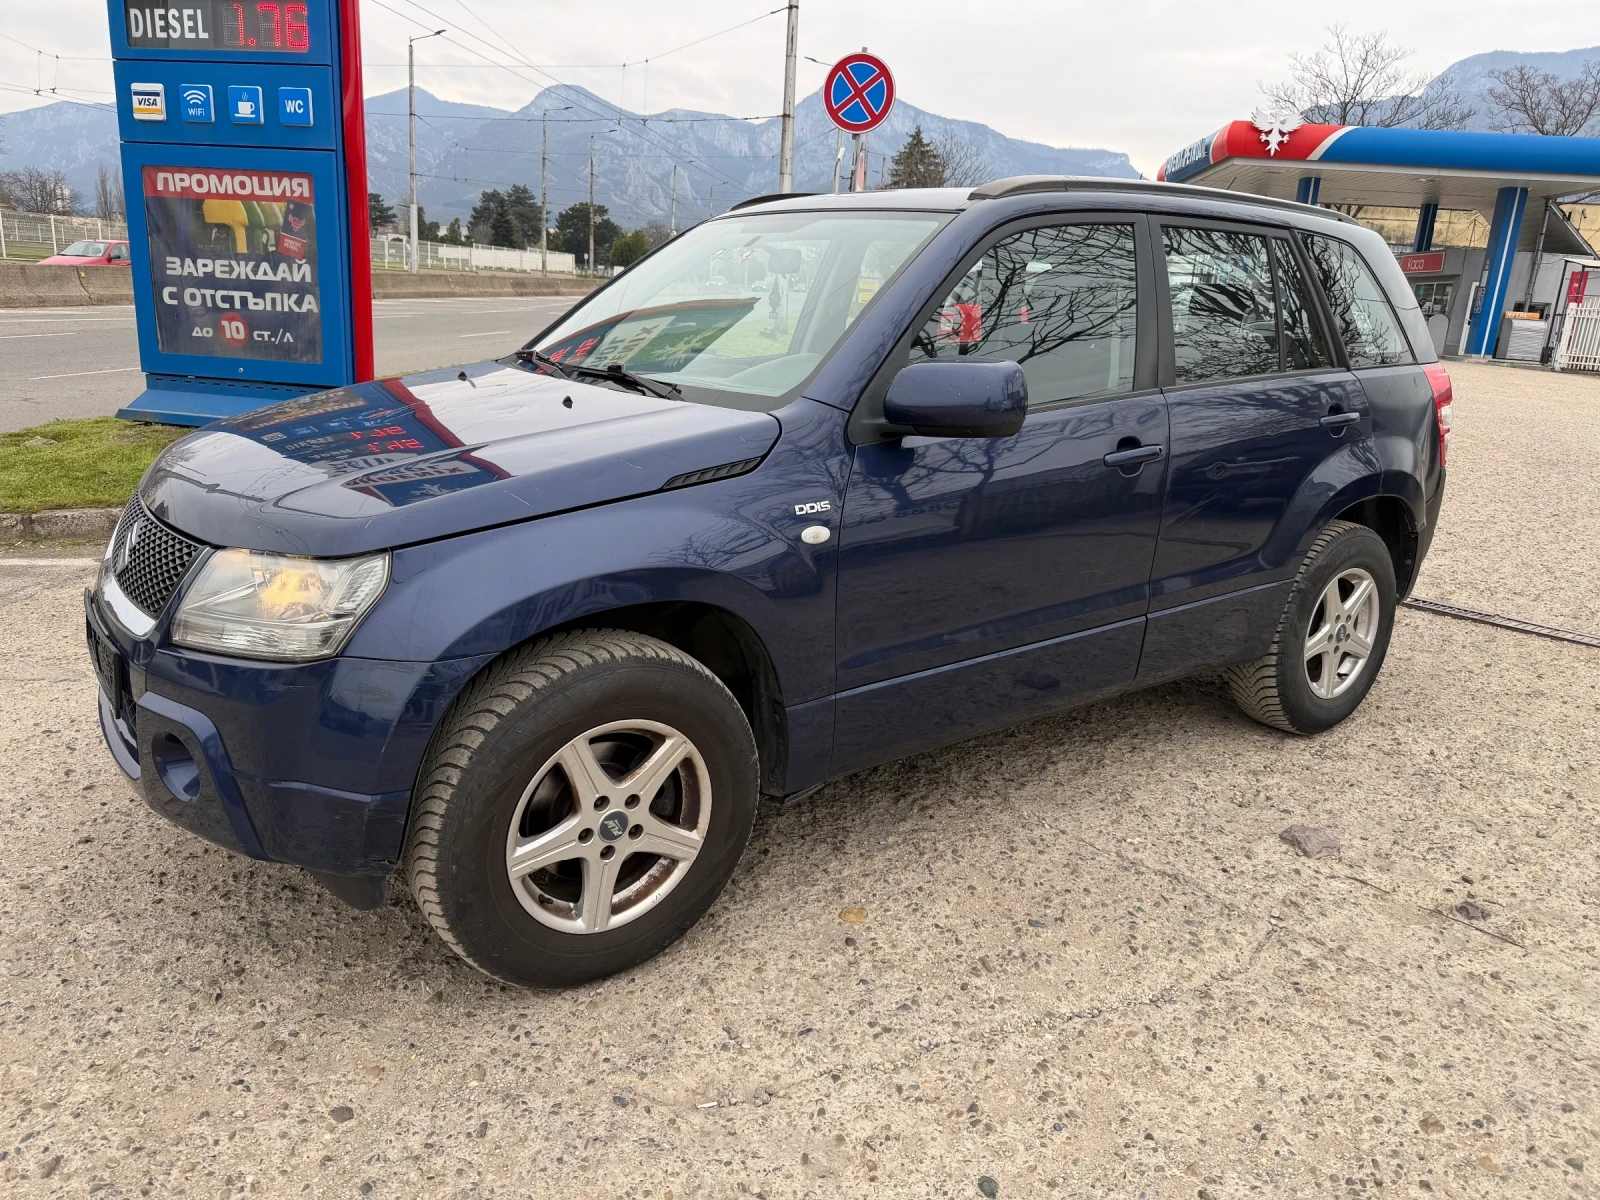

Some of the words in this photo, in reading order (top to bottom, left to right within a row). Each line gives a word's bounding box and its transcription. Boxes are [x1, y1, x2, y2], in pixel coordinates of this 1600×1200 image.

[129, 8, 209, 39] DIESEL
[232, 3, 309, 48] 1.76
[137, 97, 158, 107] VISA
[285, 100, 304, 114] WC
[156, 172, 310, 198] ПРОМОЦИЯ
[165, 256, 312, 283] ЗАРЕЖДАЙ
[162, 286, 178, 305] С
[183, 287, 319, 313] ОТСТЪПКА
[220, 320, 245, 340] 10
